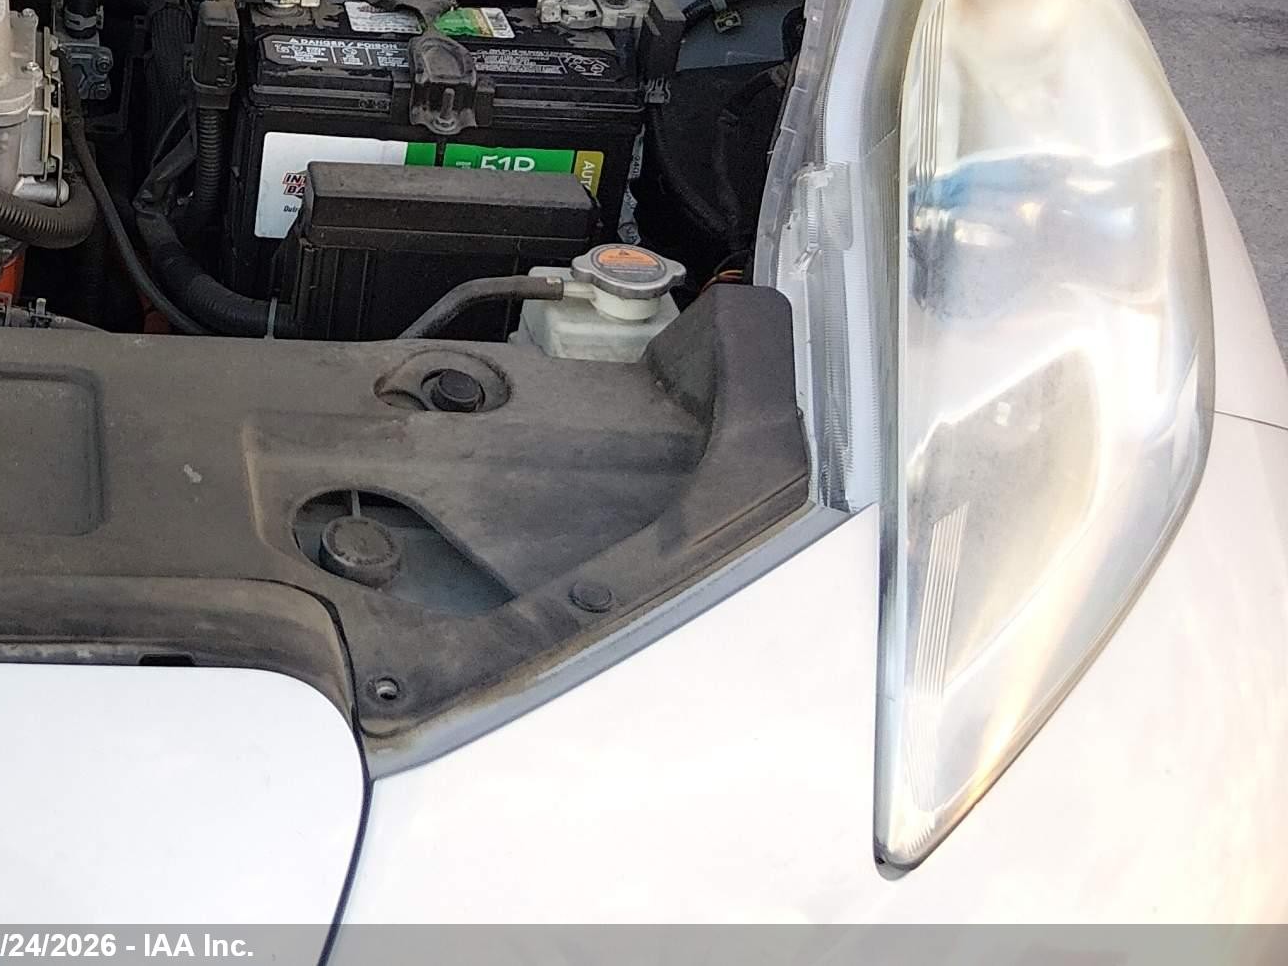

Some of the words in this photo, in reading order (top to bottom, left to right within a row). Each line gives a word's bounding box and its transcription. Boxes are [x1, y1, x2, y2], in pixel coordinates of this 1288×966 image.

[300, 38, 344, 48] DANGER
[357, 42, 398, 50] POISON
[580, 160, 597, 191] AUT
